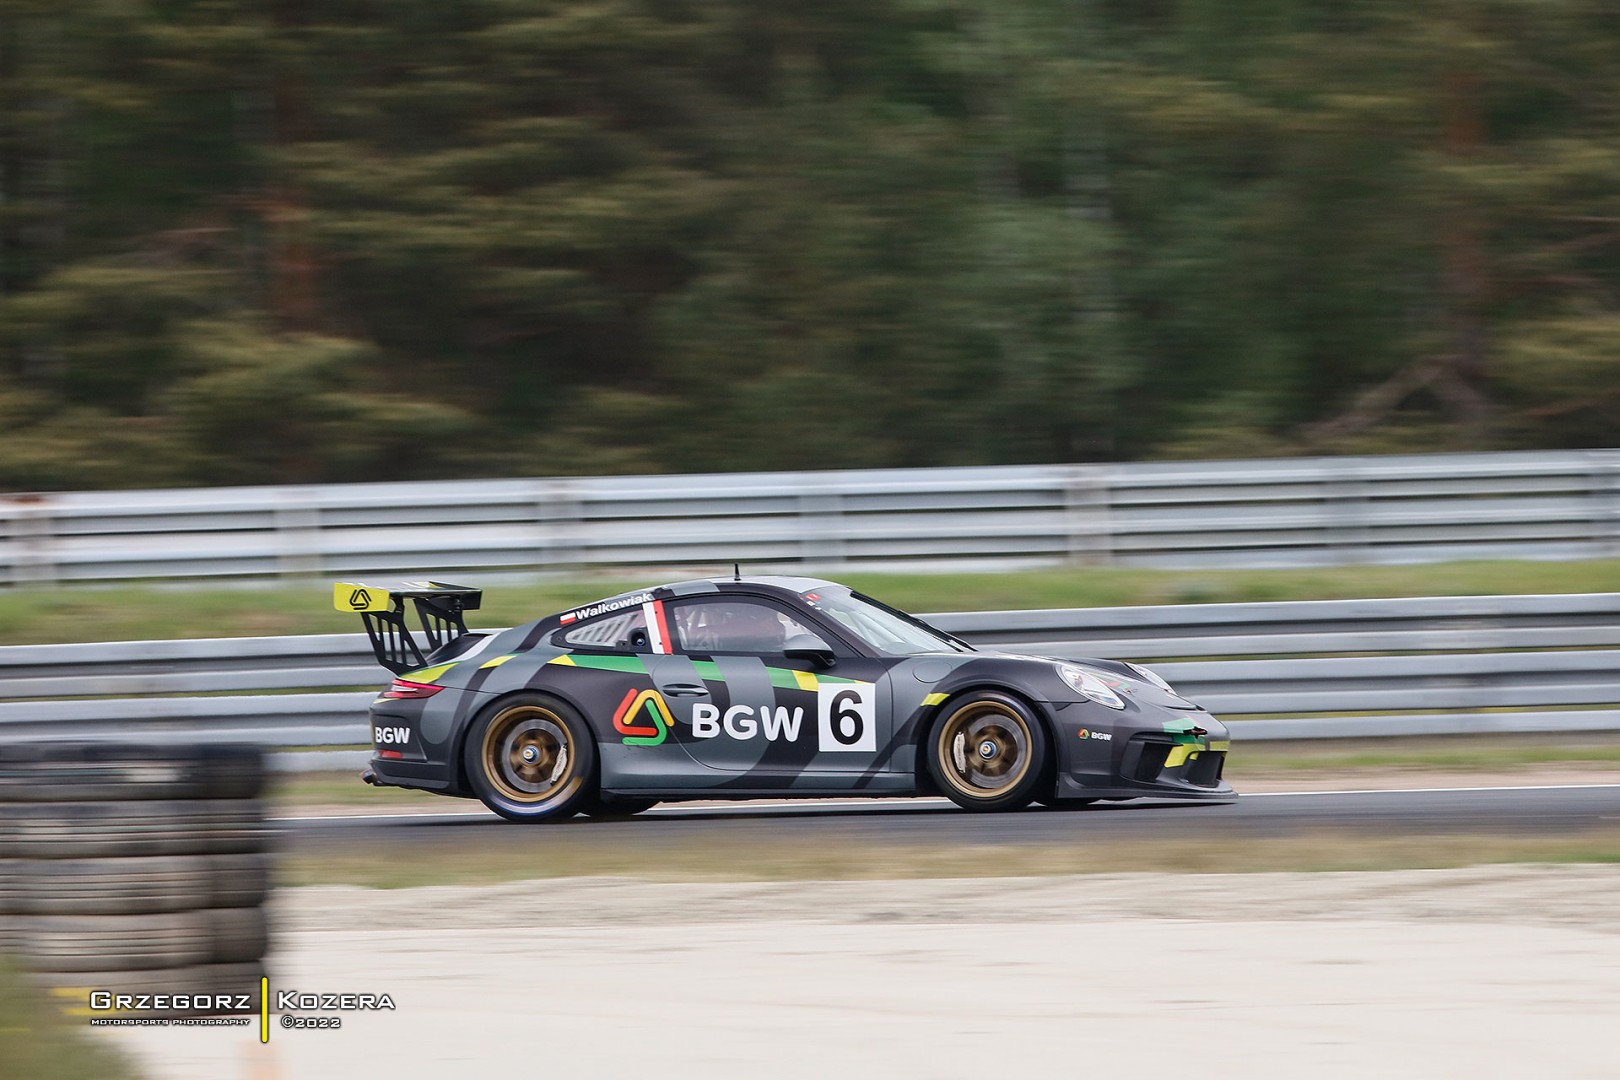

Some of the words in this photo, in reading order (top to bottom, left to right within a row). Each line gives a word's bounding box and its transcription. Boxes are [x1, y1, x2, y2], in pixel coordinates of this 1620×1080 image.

[576, 593, 653, 620] Walkowiak
[692, 703, 804, 742] BGW
[830, 690, 864, 745] 6
[375, 726, 411, 744] BGW
[1091, 731, 1112, 741] BGW
